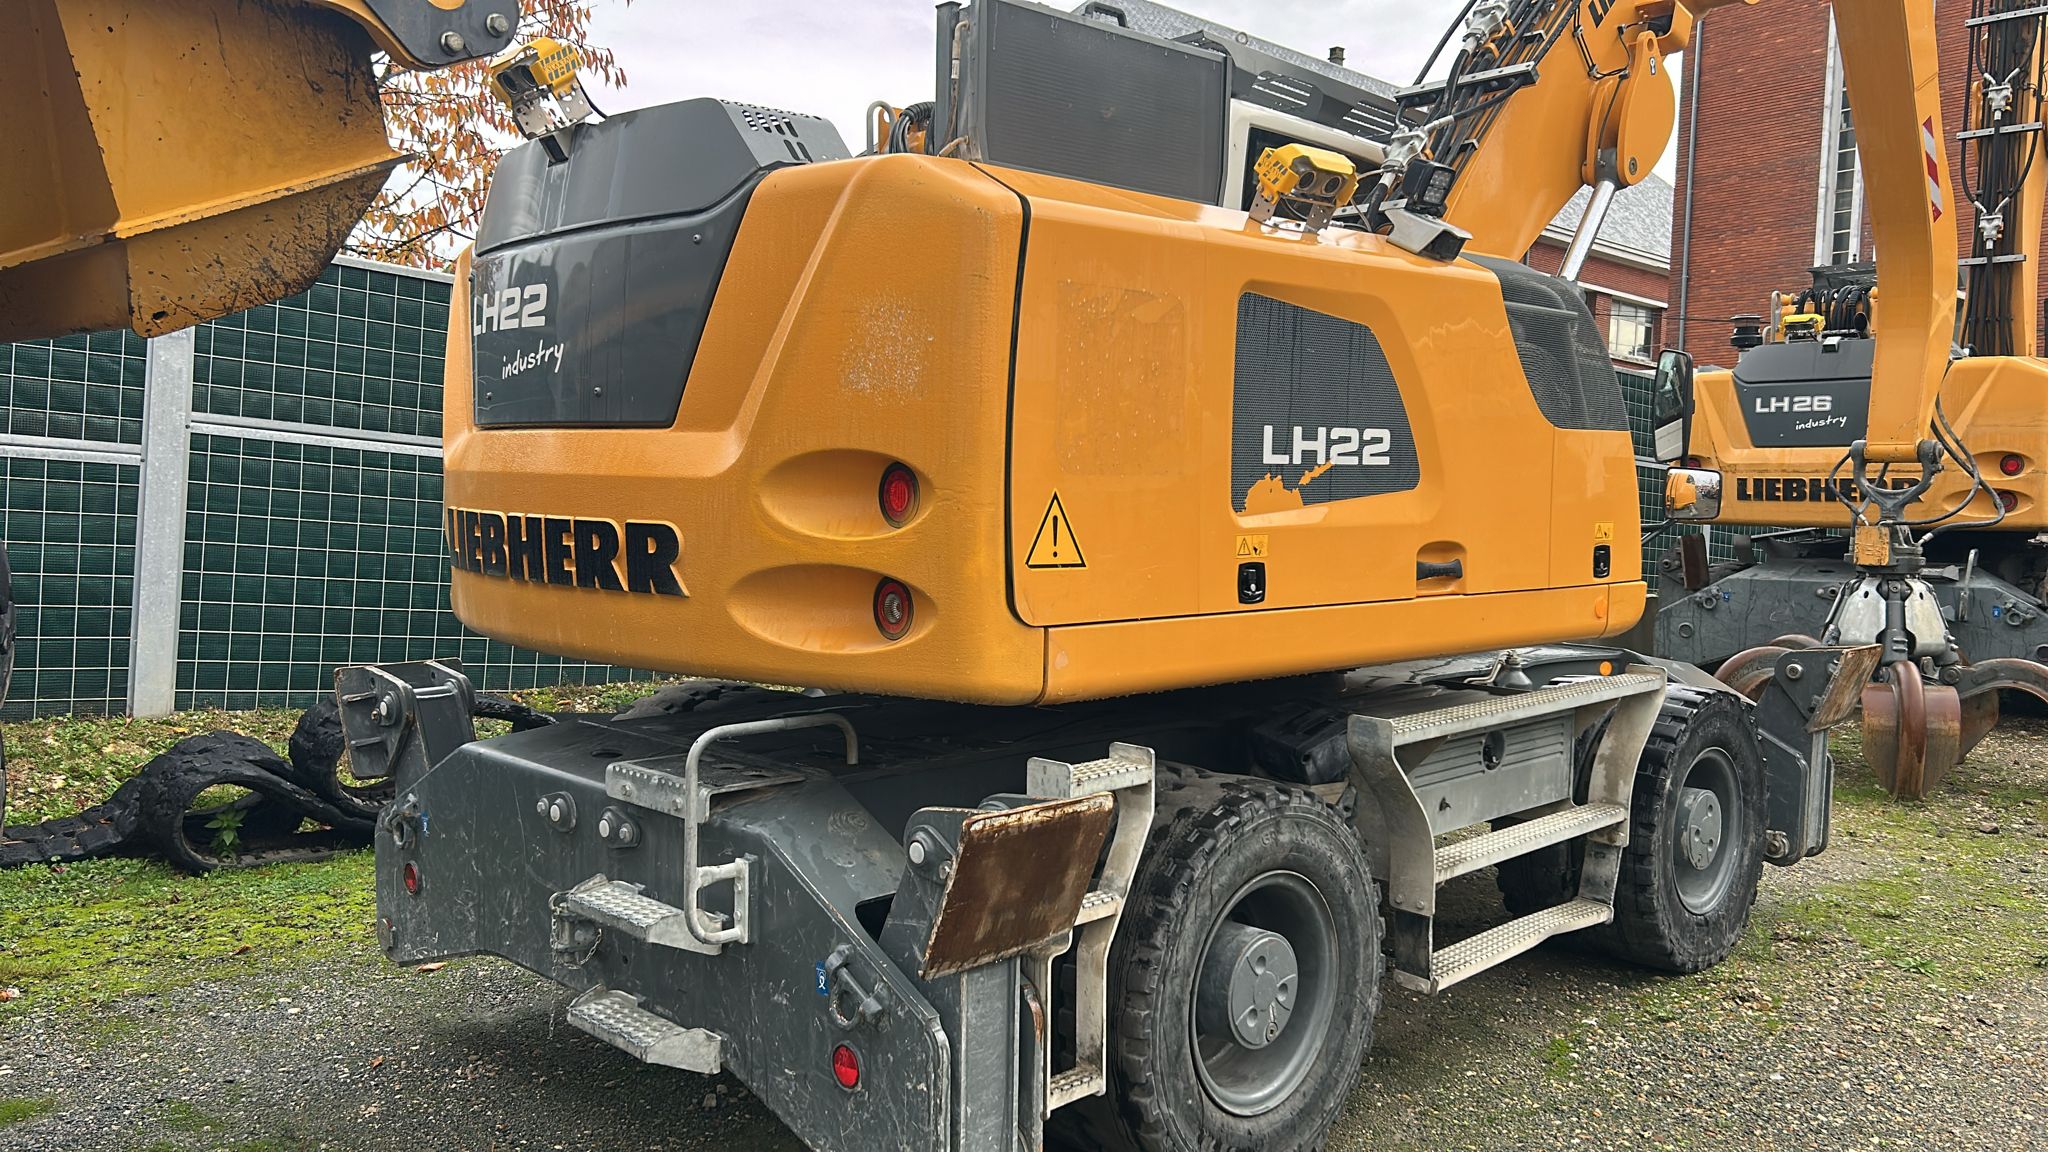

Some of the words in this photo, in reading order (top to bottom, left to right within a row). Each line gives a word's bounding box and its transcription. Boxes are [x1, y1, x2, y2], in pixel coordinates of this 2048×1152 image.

[473, 283, 548, 336] LH22
[501, 339, 564, 380] industry
[1755, 395, 1833, 413] LH26
[1795, 415, 1847, 430] industry
[1263, 425, 1391, 465] LH22
[447, 506, 691, 598] LIEBHERR
